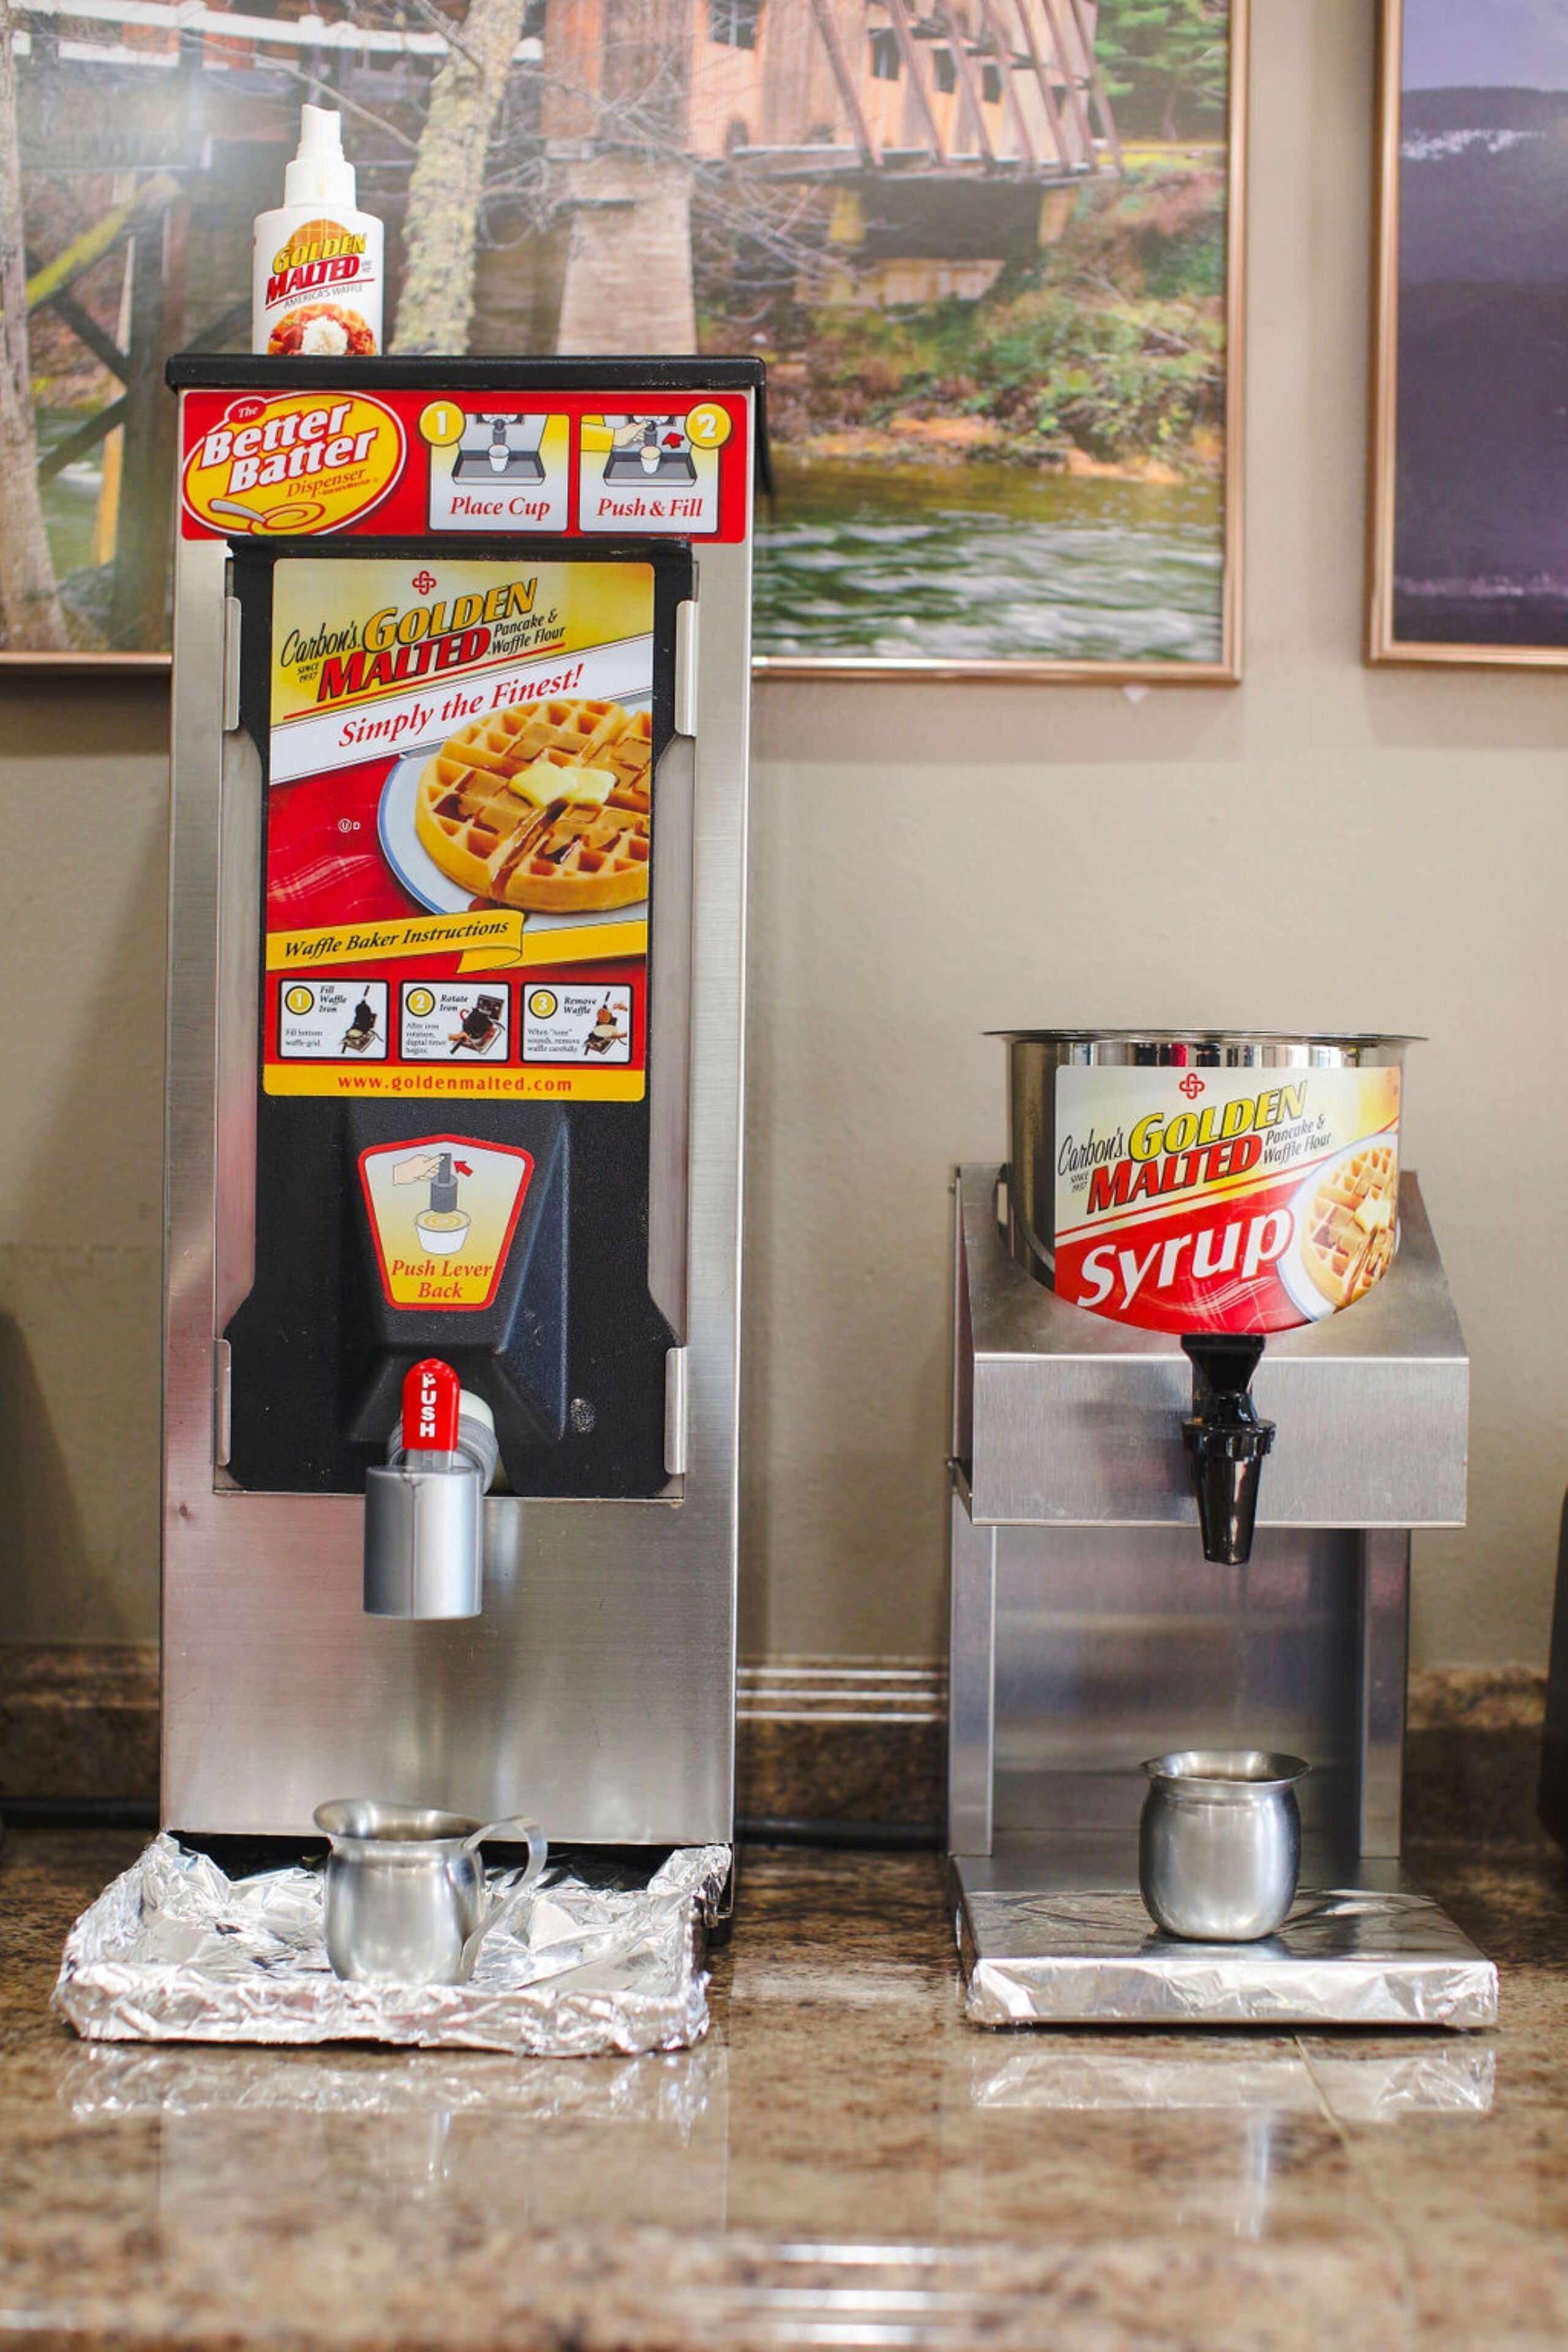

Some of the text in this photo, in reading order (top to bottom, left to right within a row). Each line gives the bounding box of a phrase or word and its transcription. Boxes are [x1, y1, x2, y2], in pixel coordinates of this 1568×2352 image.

[273, 234, 367, 275] GOLDEN
[266, 255, 360, 305] MALTED
[284, 287, 331, 309] AMERICA'S
[238, 406, 258, 418] The
[437, 411, 448, 435] 1
[697, 414, 717, 437] 2
[199, 402, 353, 469] Better
[227, 429, 379, 496] Batter
[287, 469, 366, 498] Dispenser
[450, 496, 550, 521] Place Cup
[597, 498, 703, 518] Push & Fill
[281, 578, 538, 668] Carbon's GOLDEN
[494, 608, 559, 638] Pancake &
[492, 626, 565, 655] Waffle Flour
[317, 627, 491, 702] MALTED
[339, 663, 584, 747] Simply the Finest!
[284, 920, 509, 960] Waffle Baker Instructions
[320, 986, 335, 994] Fill
[320, 995, 347, 1005] Waffle
[416, 995, 425, 1009] 2
[538, 996, 548, 1010] 3
[564, 1006, 590, 1017] Waffle
[337, 1074, 571, 1091] www.goldenmalted.com
[1057, 1079, 1308, 1176] Carbon's GOLDEN
[1266, 1114, 1325, 1146] Pancake &
[1264, 1133, 1331, 1164] Waffle Flour
[1087, 1134, 1262, 1214] MALTED
[391, 1259, 492, 1278] Push Lever
[1076, 1208, 1290, 1310] Syrup
[418, 1281, 462, 1298] Back
[420, 1372, 437, 1438] PUSH
